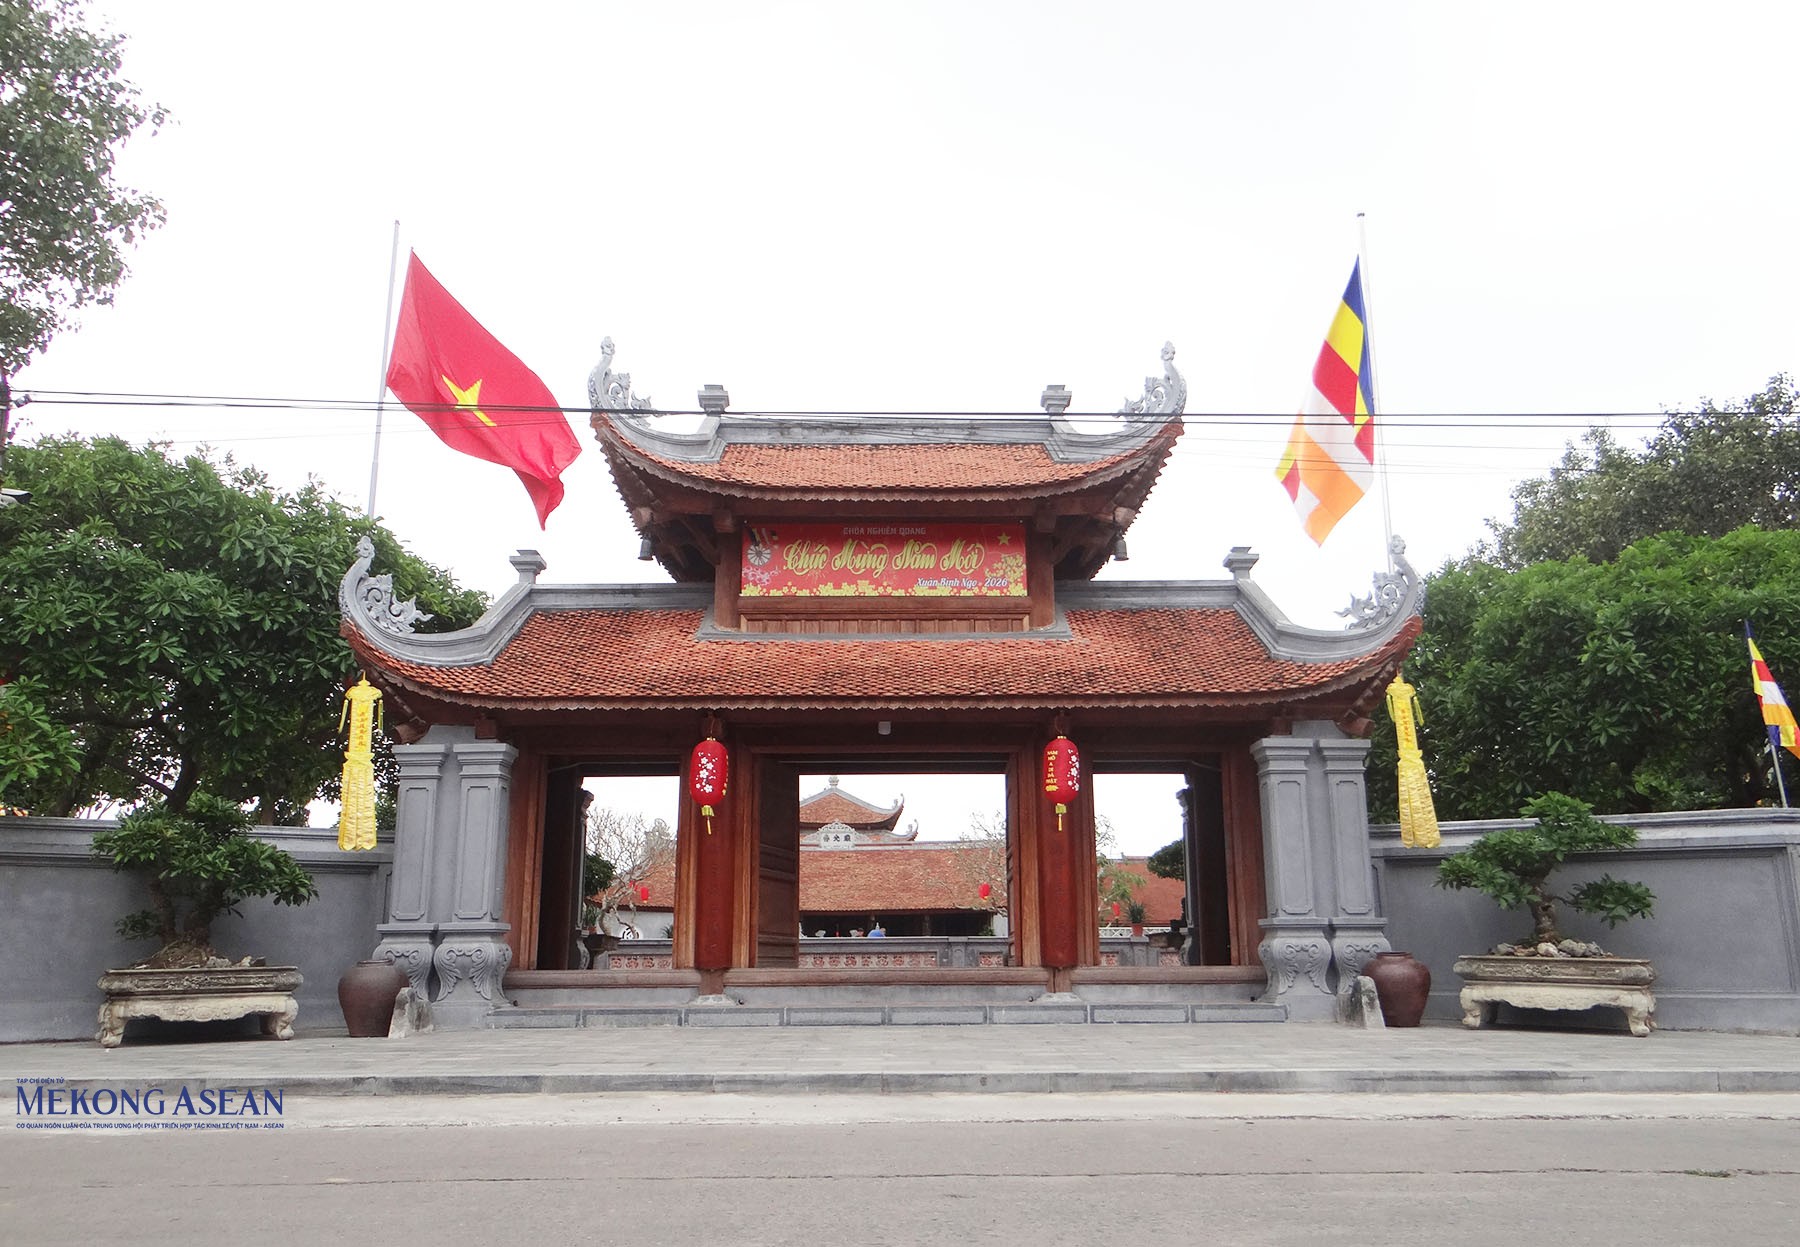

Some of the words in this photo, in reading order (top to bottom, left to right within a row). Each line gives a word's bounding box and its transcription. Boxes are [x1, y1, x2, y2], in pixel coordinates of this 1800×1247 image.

[783, 539, 830, 575] Chúc
[831, 538, 889, 578] Mừng
[892, 539, 938, 570] Năm
[939, 539, 985, 575] Mới
[917, 577, 938, 586] Xuân
[984, 577, 1008, 587] 2026
